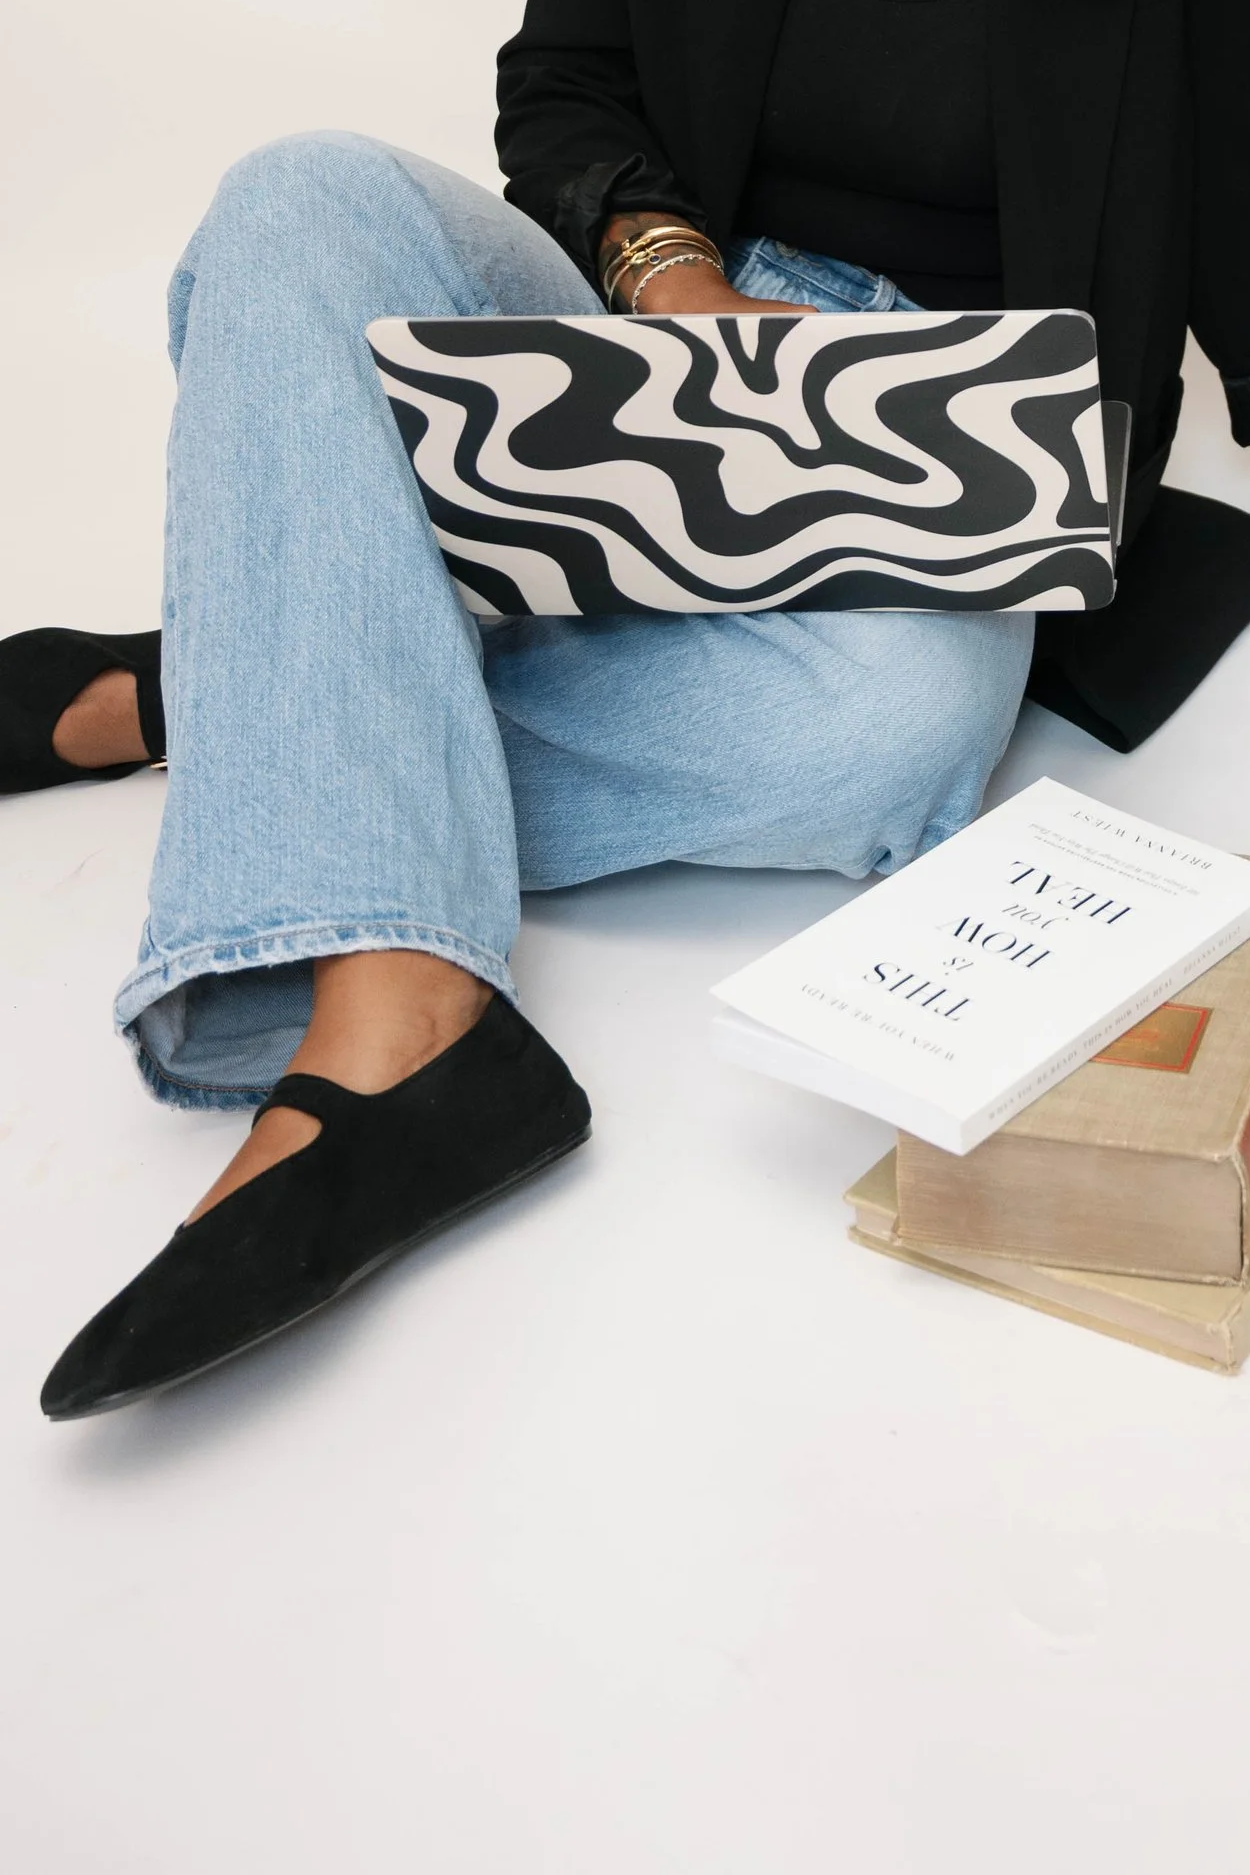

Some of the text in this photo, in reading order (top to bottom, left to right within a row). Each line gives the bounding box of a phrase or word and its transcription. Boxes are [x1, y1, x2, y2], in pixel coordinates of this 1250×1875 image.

[1070, 810, 1127, 838] WIEST
[1133, 835, 1213, 870] BRIANNA
[1007, 861, 1132, 925] HEAL
[1001, 901, 1070, 931] you
[936, 914, 1052, 969] HOW
[941, 955, 975, 977] is
[862, 961, 970, 1021] THIS
